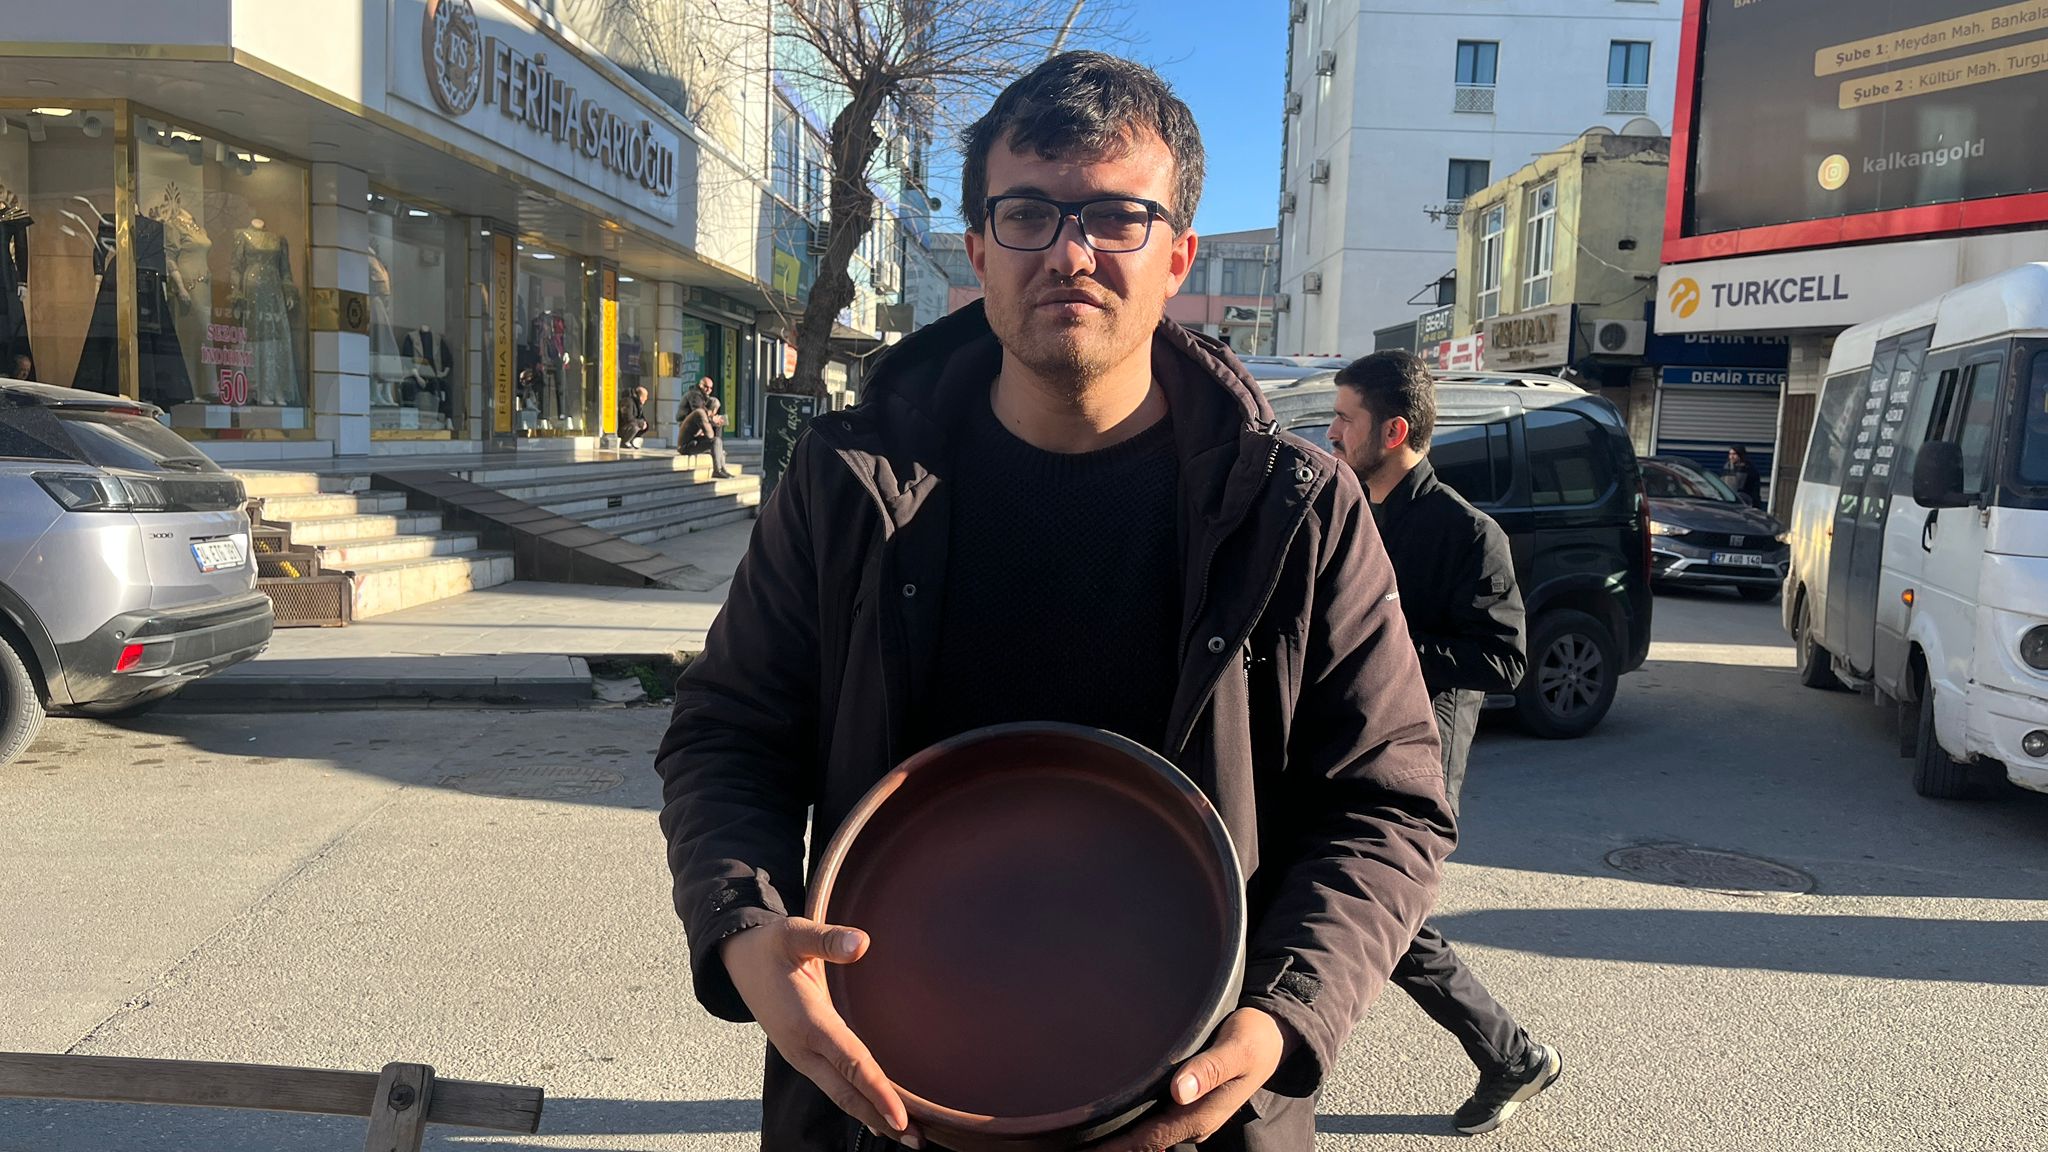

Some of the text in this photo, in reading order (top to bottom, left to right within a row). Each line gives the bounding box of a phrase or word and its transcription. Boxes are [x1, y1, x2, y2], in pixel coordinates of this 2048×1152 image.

[1835, 47, 1871, 66] Şube
[1894, 30, 1946, 52] Meydan
[1951, 21, 1985, 38] Mah.
[1853, 84, 1889, 102] Şube
[1894, 80, 1904, 93] 2
[1919, 68, 1962, 88] Kültür
[1966, 61, 2001, 78] Mah.
[485, 36, 674, 197] FERİHA SARIOĞLU
[1863, 139, 1985, 173] kalkangold
[1711, 274, 1849, 308] TURKCELL
[207, 324, 247, 343] SEZON
[1425, 311, 1449, 332] BERAT
[219, 369, 248, 406] 50
[1691, 369, 1742, 384] DEMİR
